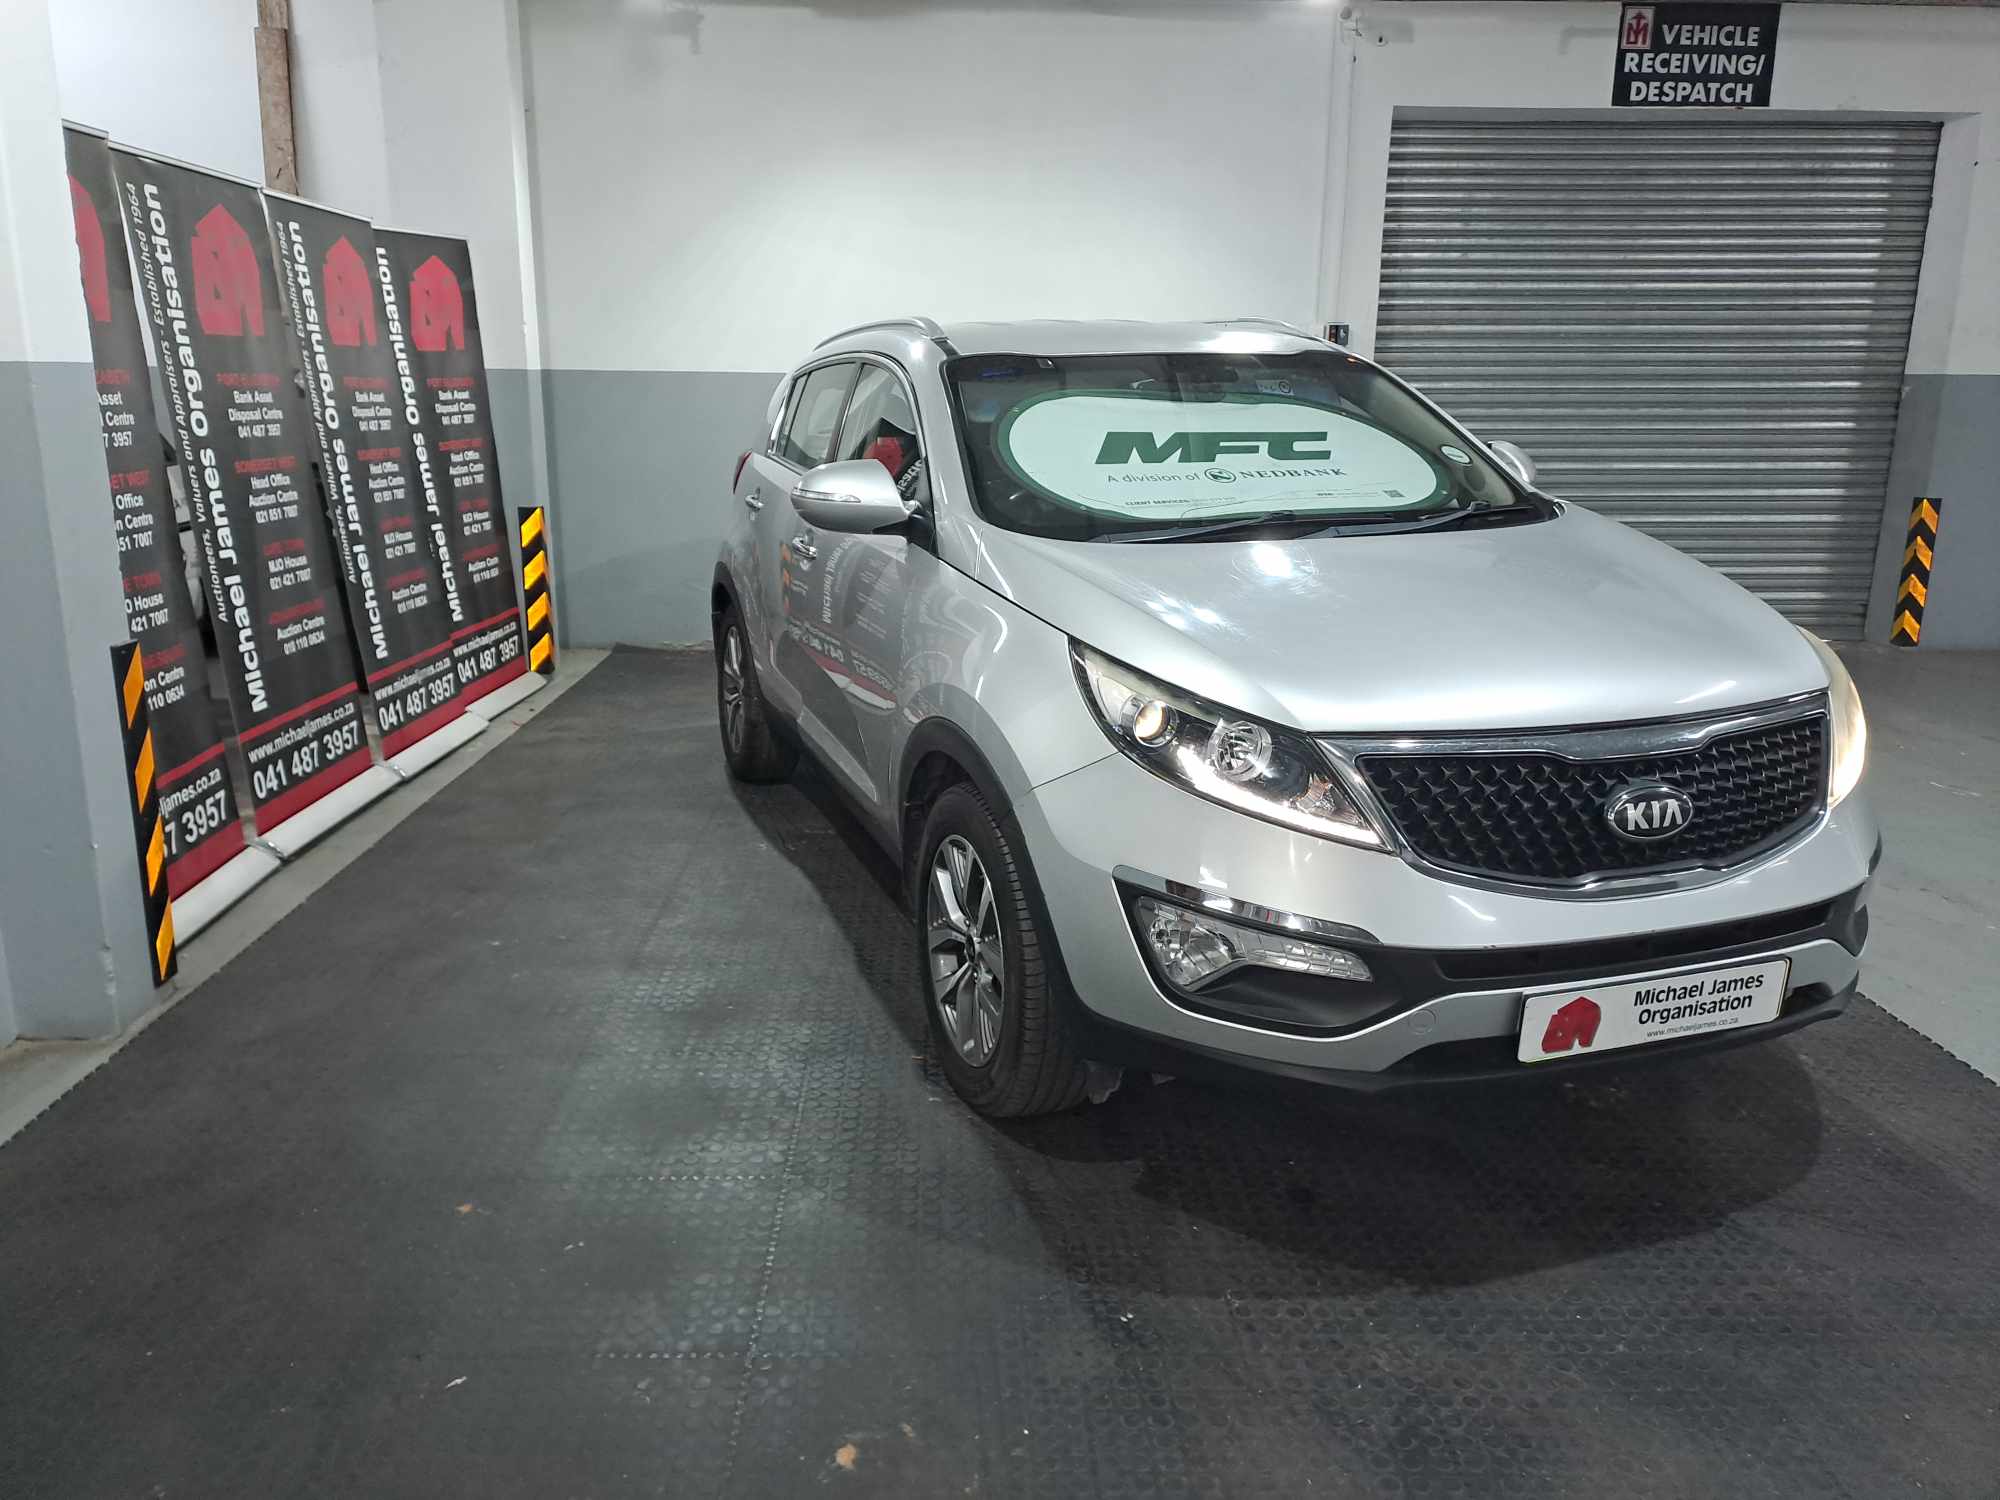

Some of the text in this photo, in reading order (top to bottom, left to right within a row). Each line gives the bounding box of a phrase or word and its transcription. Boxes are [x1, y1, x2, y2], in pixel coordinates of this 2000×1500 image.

[1662, 24, 1760, 47] VEHICLE
[1623, 53, 1766, 76] RECEIVING/
[1629, 81, 1753, 103] DESPATCH
[125, 182, 143, 225] 1964
[277, 221, 289, 256] 1964
[136, 228, 163, 325] Established
[282, 259, 305, 338] Established
[375, 247, 420, 425] Organisation
[161, 341, 186, 427] Appraisers
[105, 411, 135, 426] Centre
[112, 431, 132, 447] 3957
[144, 184, 268, 712] Michael James Organisation
[178, 429, 193, 460] and
[288, 221, 388, 659] Michael James Organisation
[1094, 431, 1331, 464] MFC
[323, 452, 338, 500] Valuers
[413, 433, 440, 516] James
[1107, 467, 1348, 484] A division of NEDBANK
[115, 493, 144, 510] Office
[188, 465, 206, 522] Valuers
[125, 512, 154, 529] Centre
[133, 530, 153, 548] 7007
[202, 529, 228, 622] Auctioneers,
[430, 523, 464, 622] Michael
[133, 593, 164, 611] House
[131, 608, 168, 633] 421 7007
[157, 665, 185, 686] Centre
[457, 635, 519, 683] 041 487 3957
[378, 672, 456, 731] 041 487 3957
[248, 702, 354, 764] www.michaeljames.co.za
[253, 720, 359, 800] 041 487 3957
[181, 789, 227, 844] 3957
[1618, 799, 1683, 830] KIA
[1633, 974, 1764, 1006] Michael James
[1638, 994, 1752, 1025] Organisation
